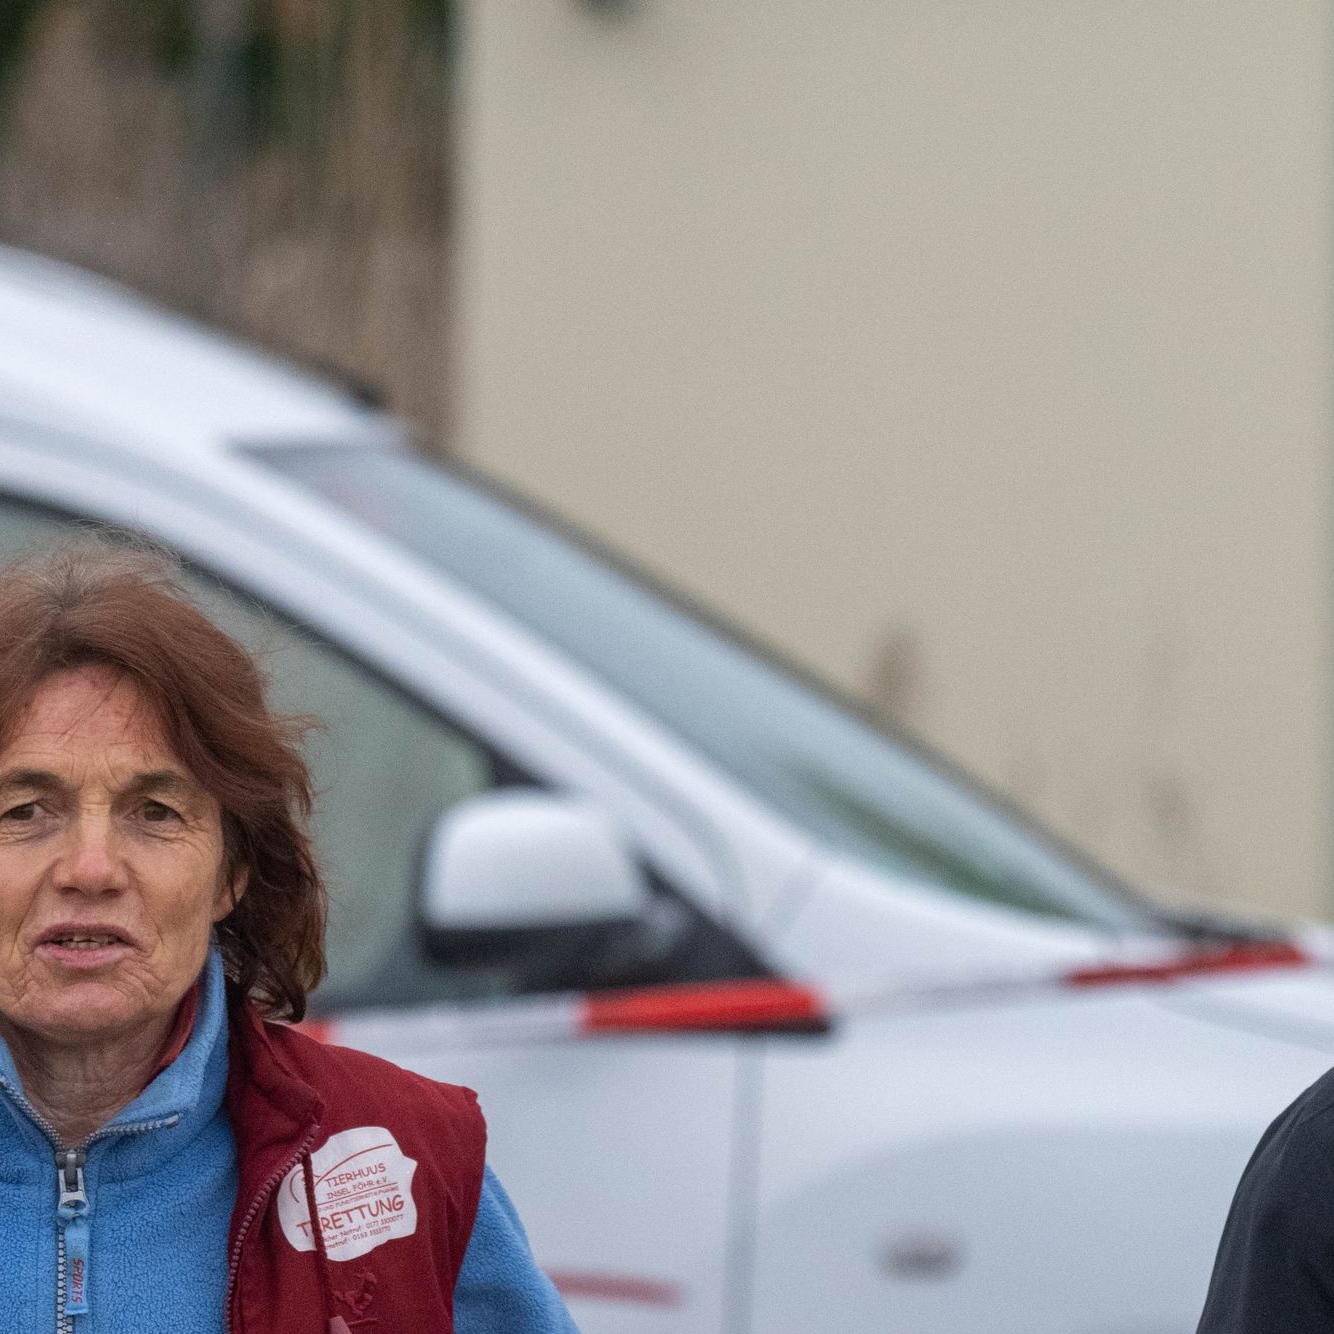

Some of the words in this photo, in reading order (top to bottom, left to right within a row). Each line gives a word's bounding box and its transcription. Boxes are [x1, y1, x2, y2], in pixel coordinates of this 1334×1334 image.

[324, 1162, 387, 1188] TIERHUUS
[326, 1187, 351, 1200] INSEL
[352, 1179, 375, 1192] FÖHR
[71, 1258, 85, 1303] SPORTS
